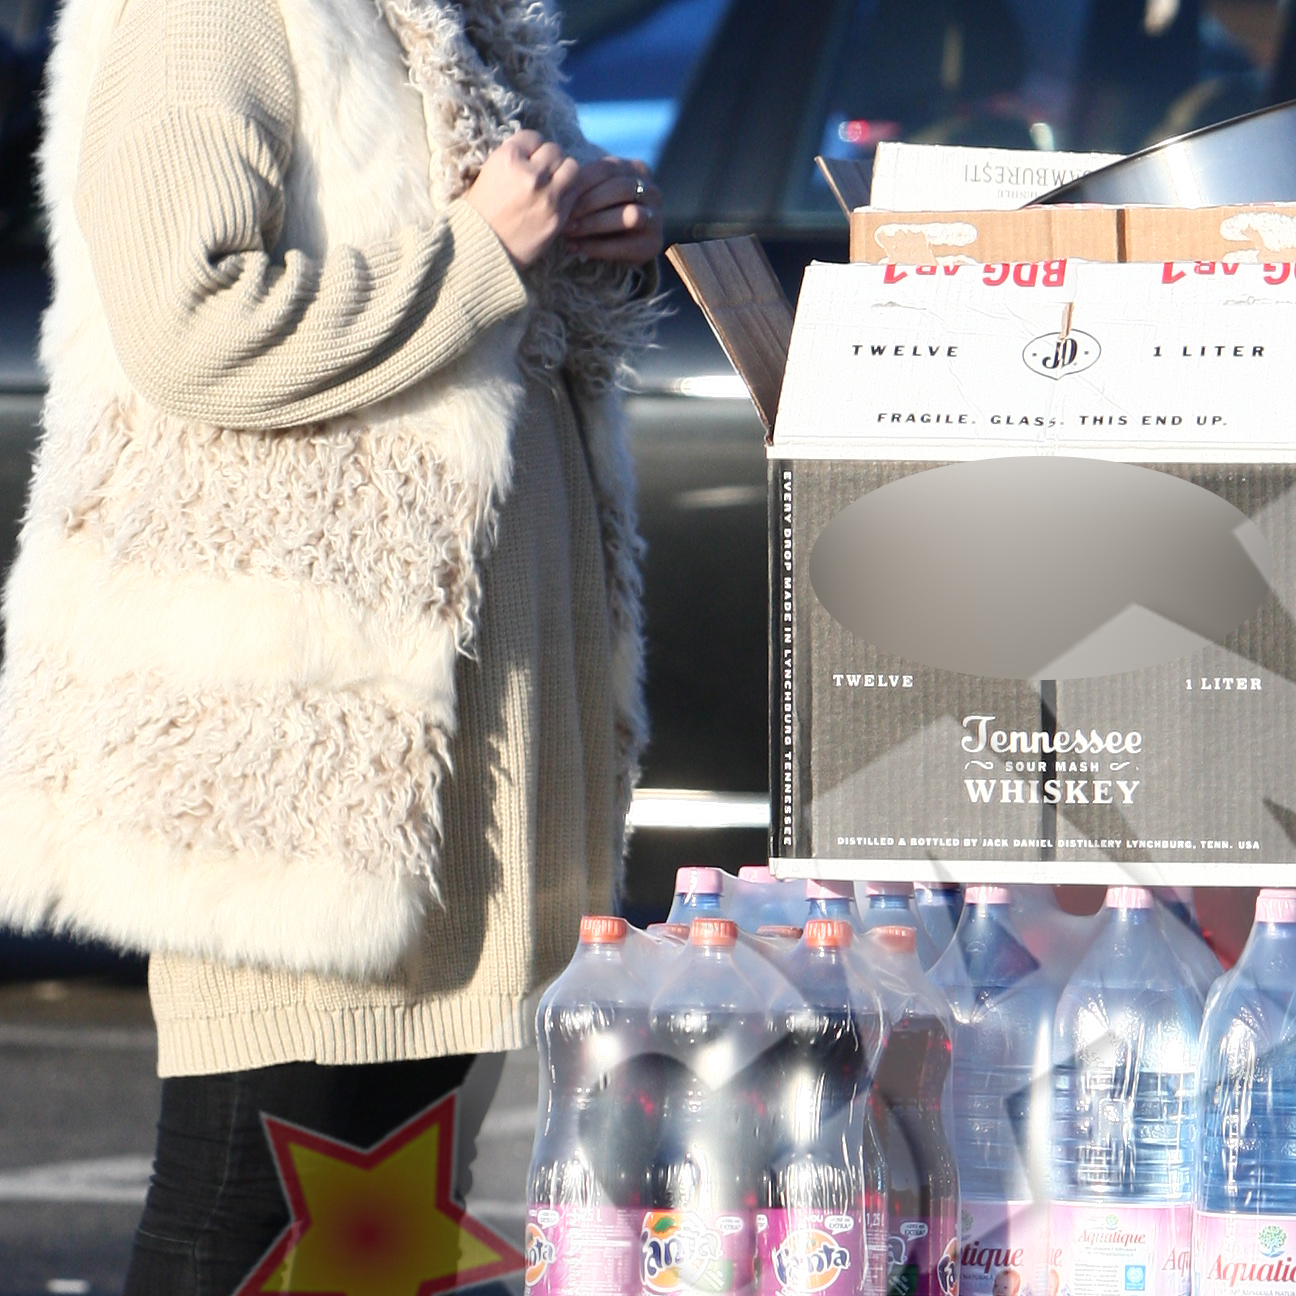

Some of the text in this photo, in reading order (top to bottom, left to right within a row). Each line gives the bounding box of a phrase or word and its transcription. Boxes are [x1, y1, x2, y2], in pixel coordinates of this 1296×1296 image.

[851, 343, 961, 358] TWELVE
[1152, 345, 1268, 358] 1 LITER
[877, 412, 977, 425] FRAGILE.
[1079, 415, 1129, 426] THIS
[1141, 415, 1184, 426] END
[1196, 415, 1229, 426] UP.
[783, 471, 793, 846] EVERY DROP MADE IN LYNCHBURG TENNESSEE
[832, 674, 914, 688] TWELVE
[1185, 677, 1264, 691] 1 LITER
[960, 714, 1143, 754] Tennessee
[1004, 761, 1100, 773] SOUR MASH
[963, 778, 1141, 805] WHISKEY
[837, 836, 895, 847] DISTILLED
[897, 837, 907, 846] &
[910, 837, 960, 847] BOTTLED
[963, 838, 979, 848] BY
[982, 838, 1010, 848] JACK
[1013, 838, 1054, 848] DANIEL
[1057, 839, 1123, 849] DISTILLERY
[1238, 840, 1261, 850] USA
[1077, 1228, 1146, 1246] Aquatique
